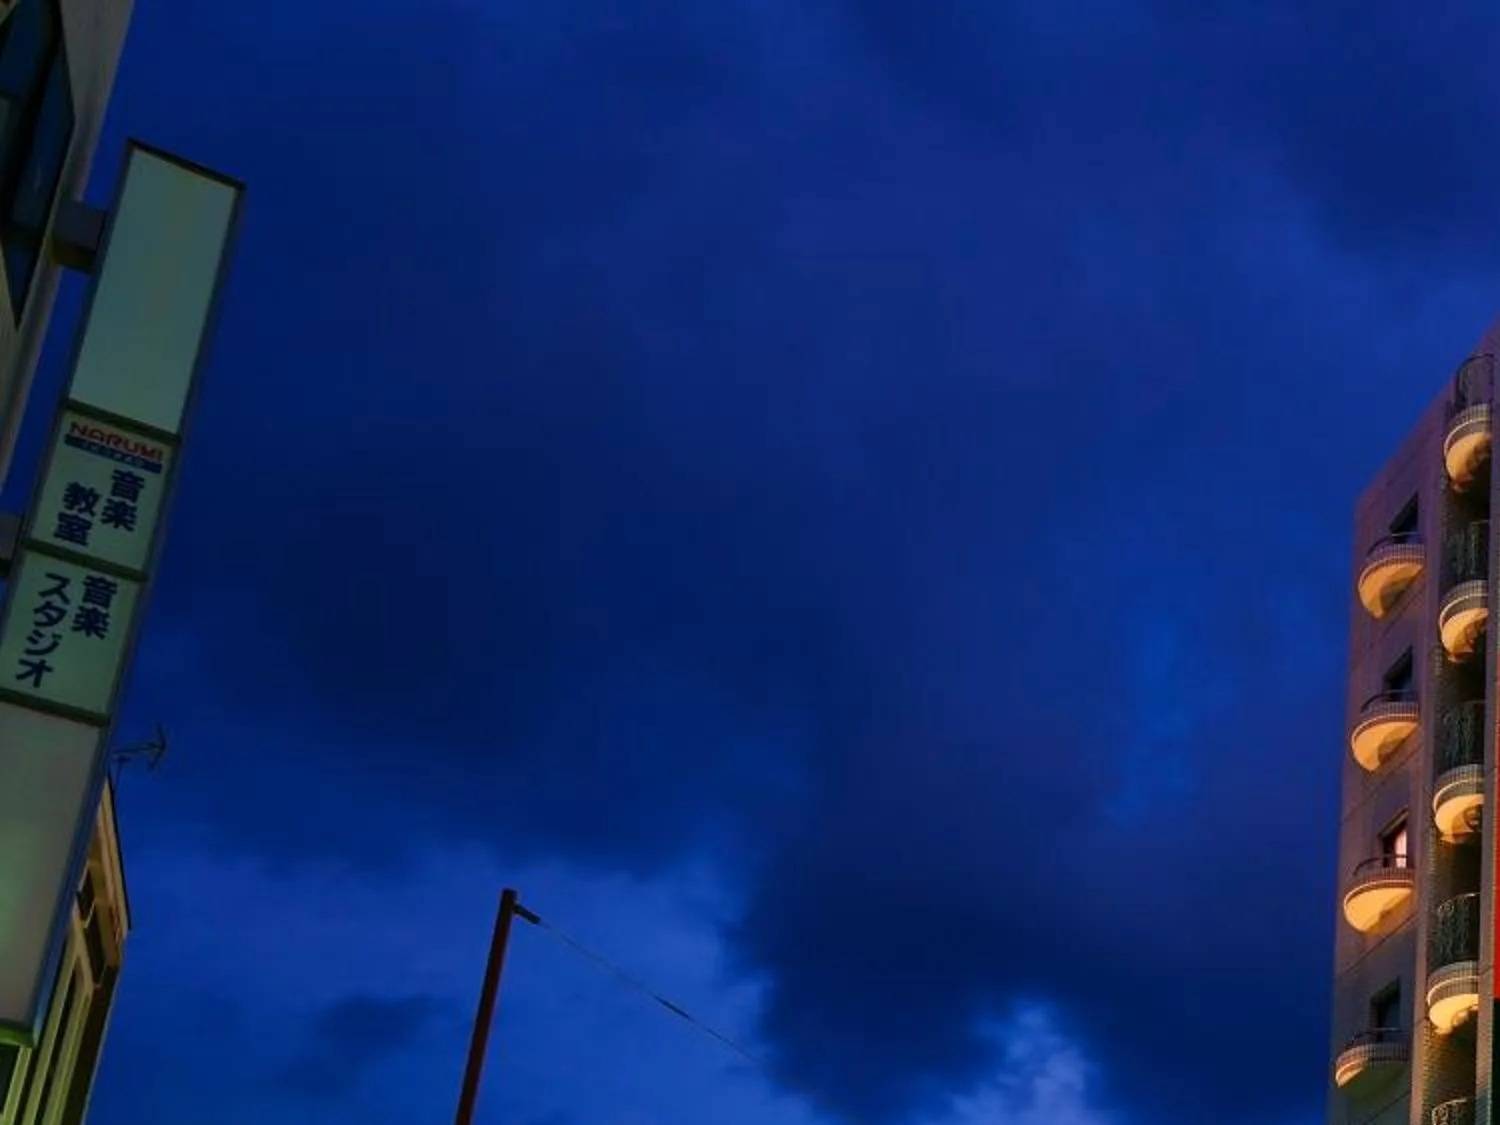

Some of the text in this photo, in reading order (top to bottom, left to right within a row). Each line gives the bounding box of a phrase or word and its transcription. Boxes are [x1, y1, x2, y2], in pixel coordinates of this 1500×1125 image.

[69, 421, 163, 461] NARUMI
[53, 481, 101, 546] 教室
[101, 469, 145, 532] 音楽
[16, 572, 71, 688] スタジオ
[71, 574, 118, 640] 音楽
